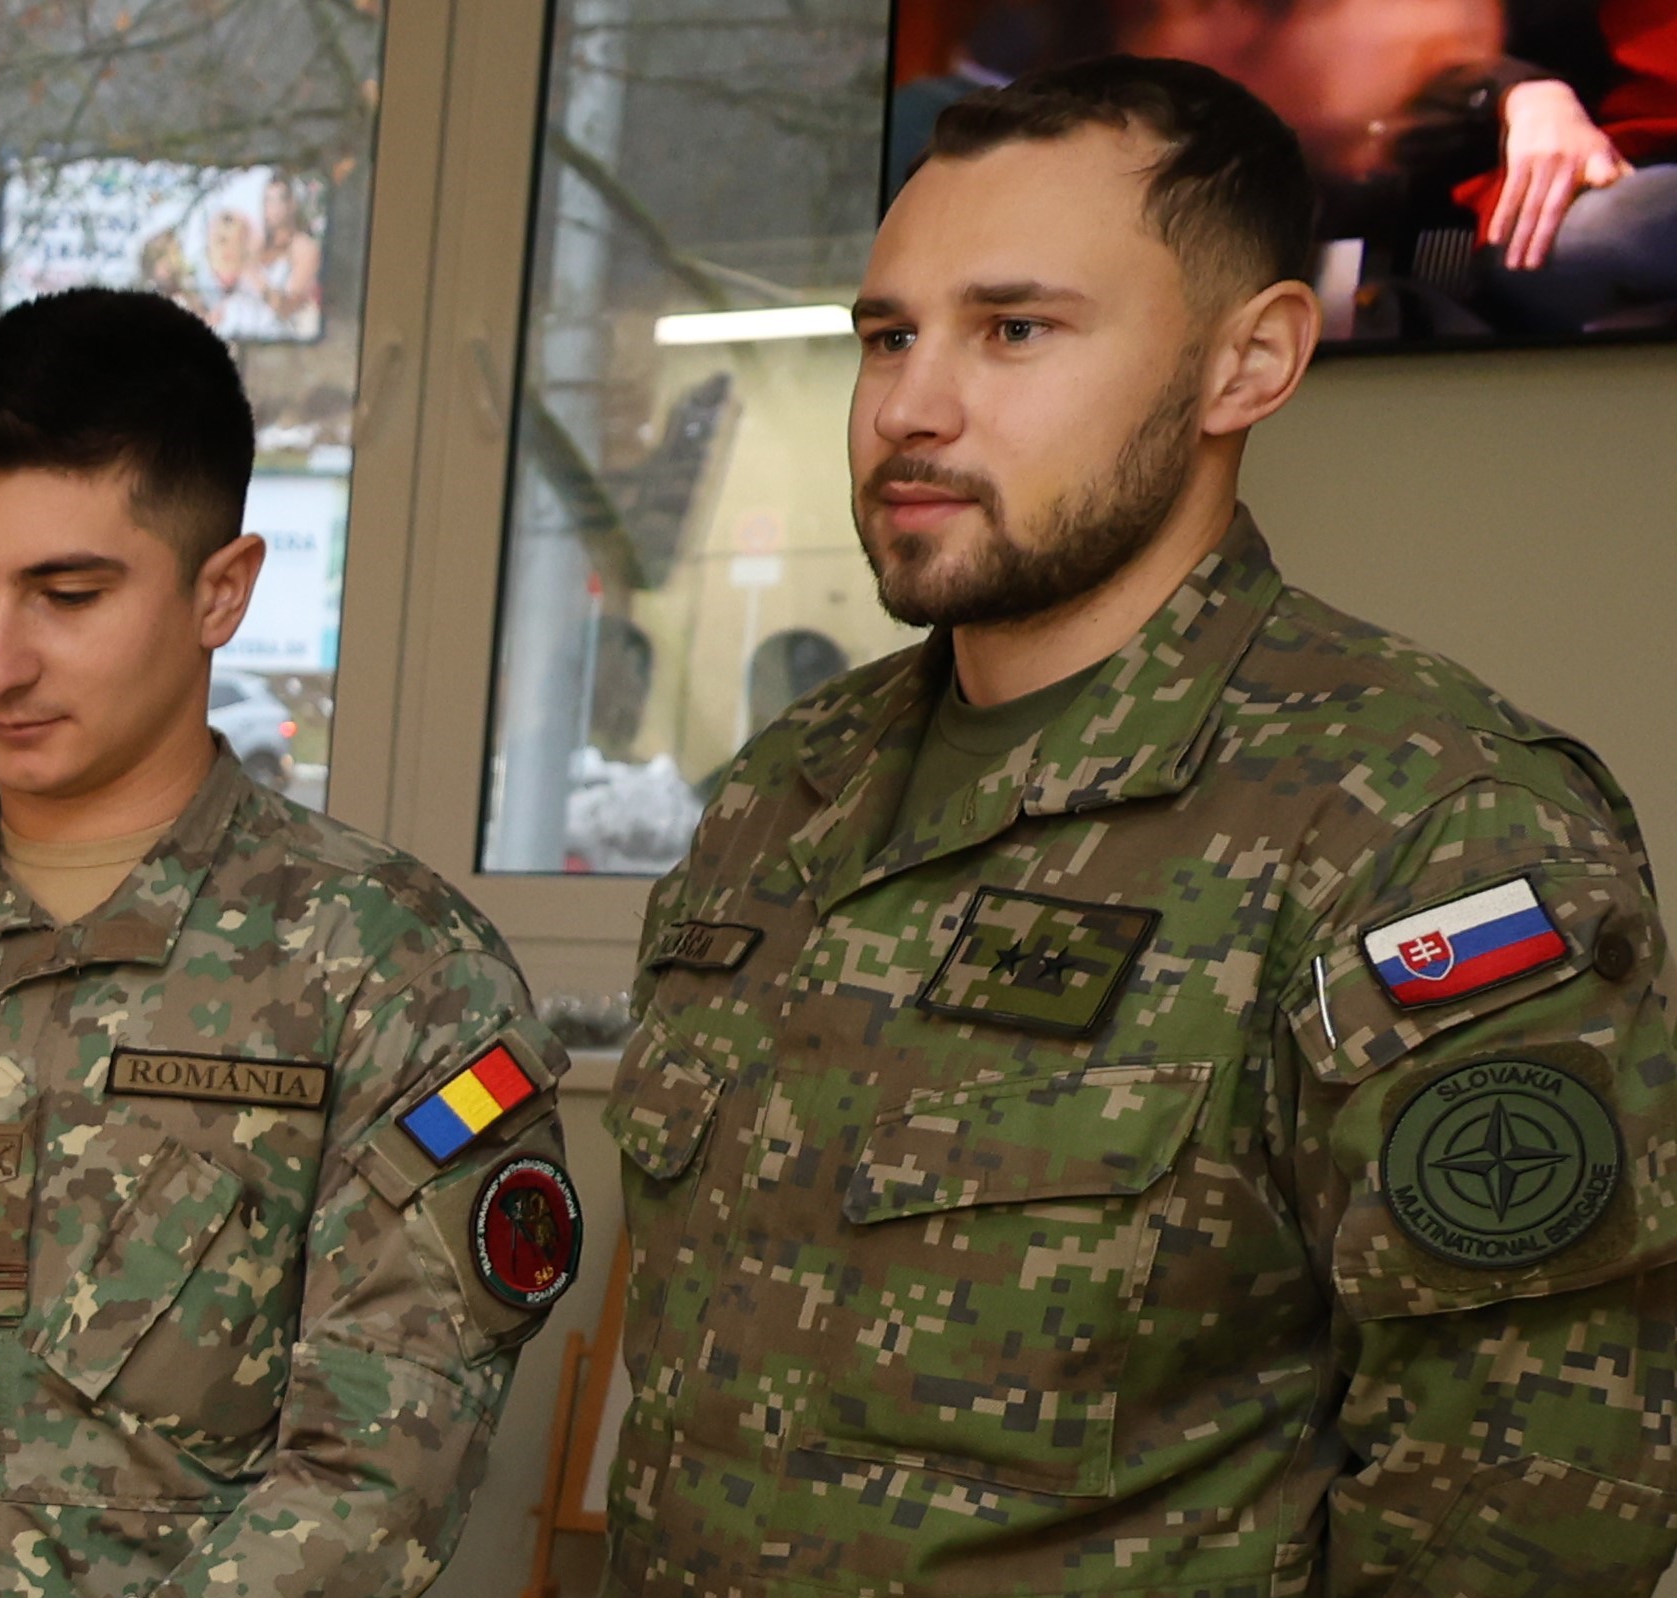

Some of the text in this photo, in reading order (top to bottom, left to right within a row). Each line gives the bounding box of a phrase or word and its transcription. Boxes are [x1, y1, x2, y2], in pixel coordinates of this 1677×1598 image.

[127, 1057, 309, 1099] ROMÂNIA
[1435, 1065, 1564, 1103] SLOVAKIA
[1394, 1162, 1614, 1260] MULTINATIONAL BRIGADE
